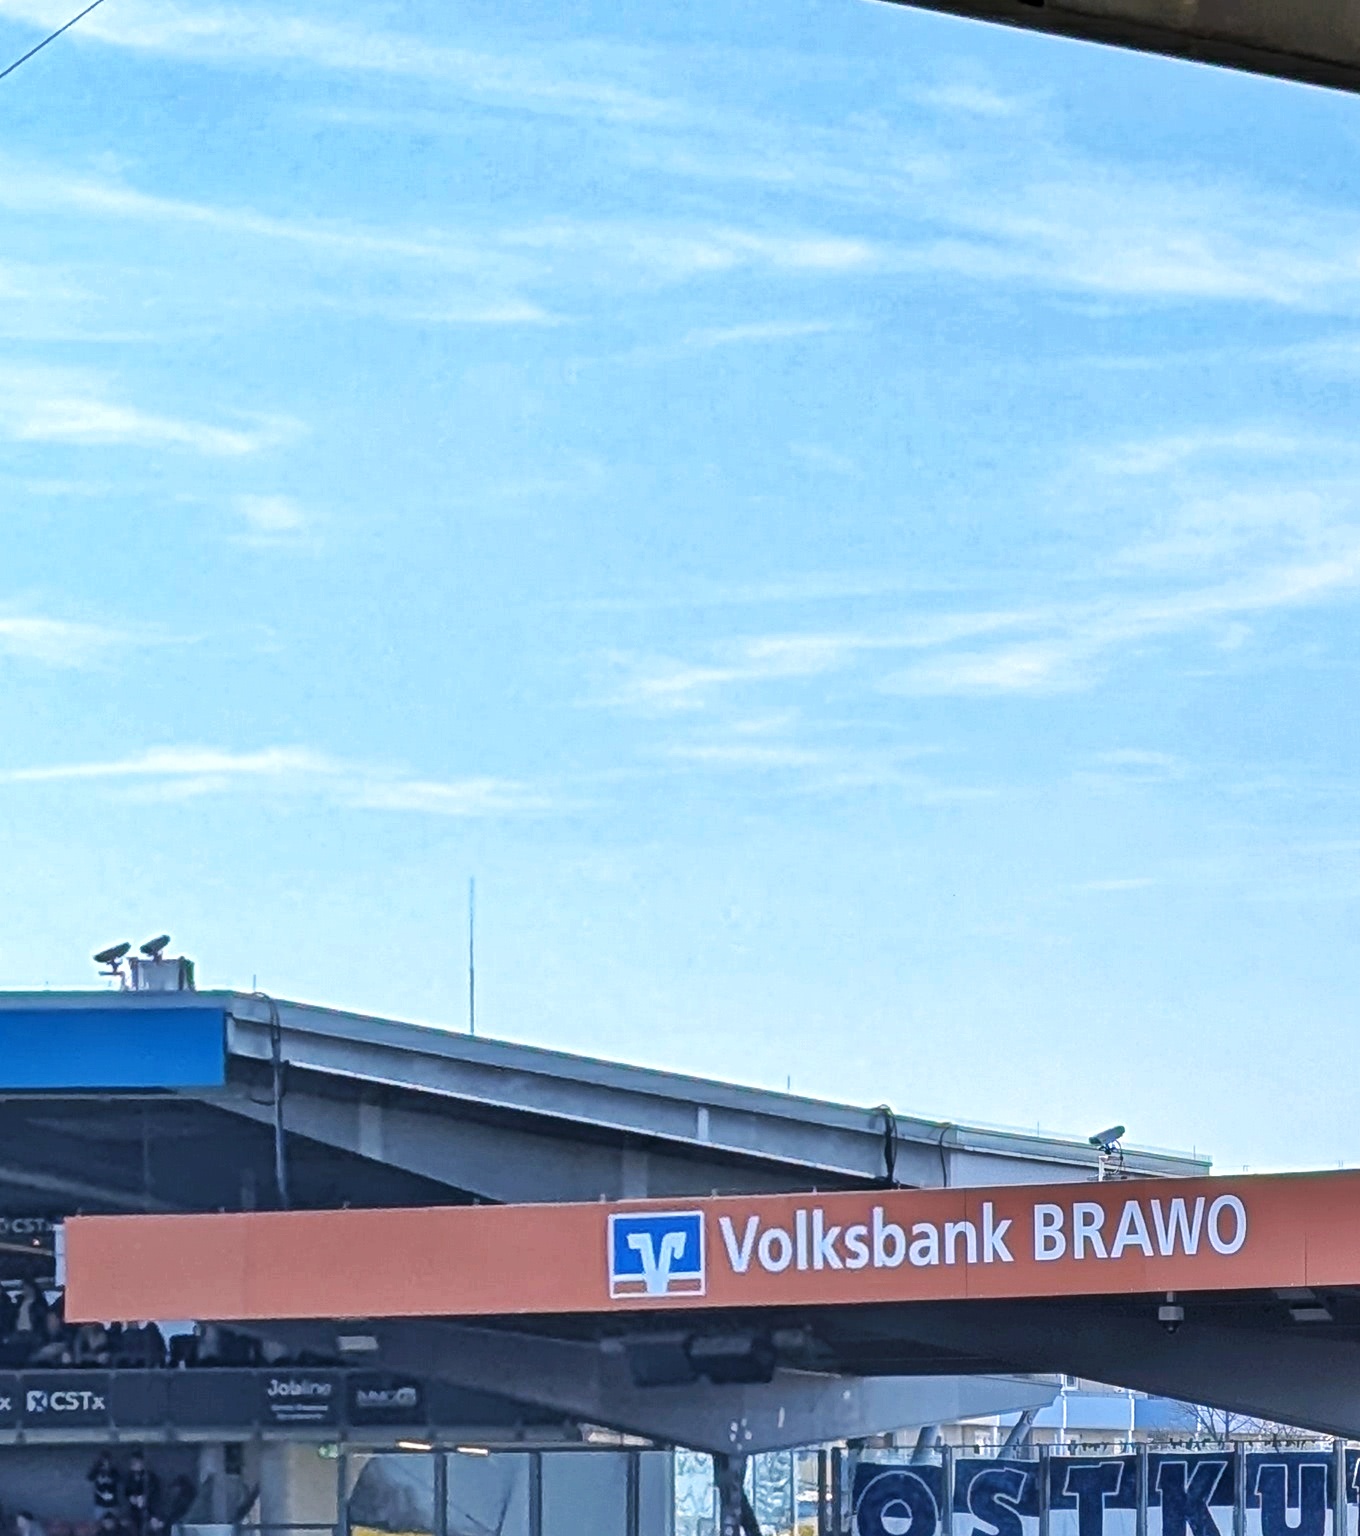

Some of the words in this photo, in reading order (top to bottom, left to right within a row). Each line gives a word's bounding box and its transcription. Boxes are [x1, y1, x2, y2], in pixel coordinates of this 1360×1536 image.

[719, 1201, 1014, 1273] Volksbank
[1032, 1193, 1248, 1261] BRAWO
[50, 1390, 106, 1411] CSTx
